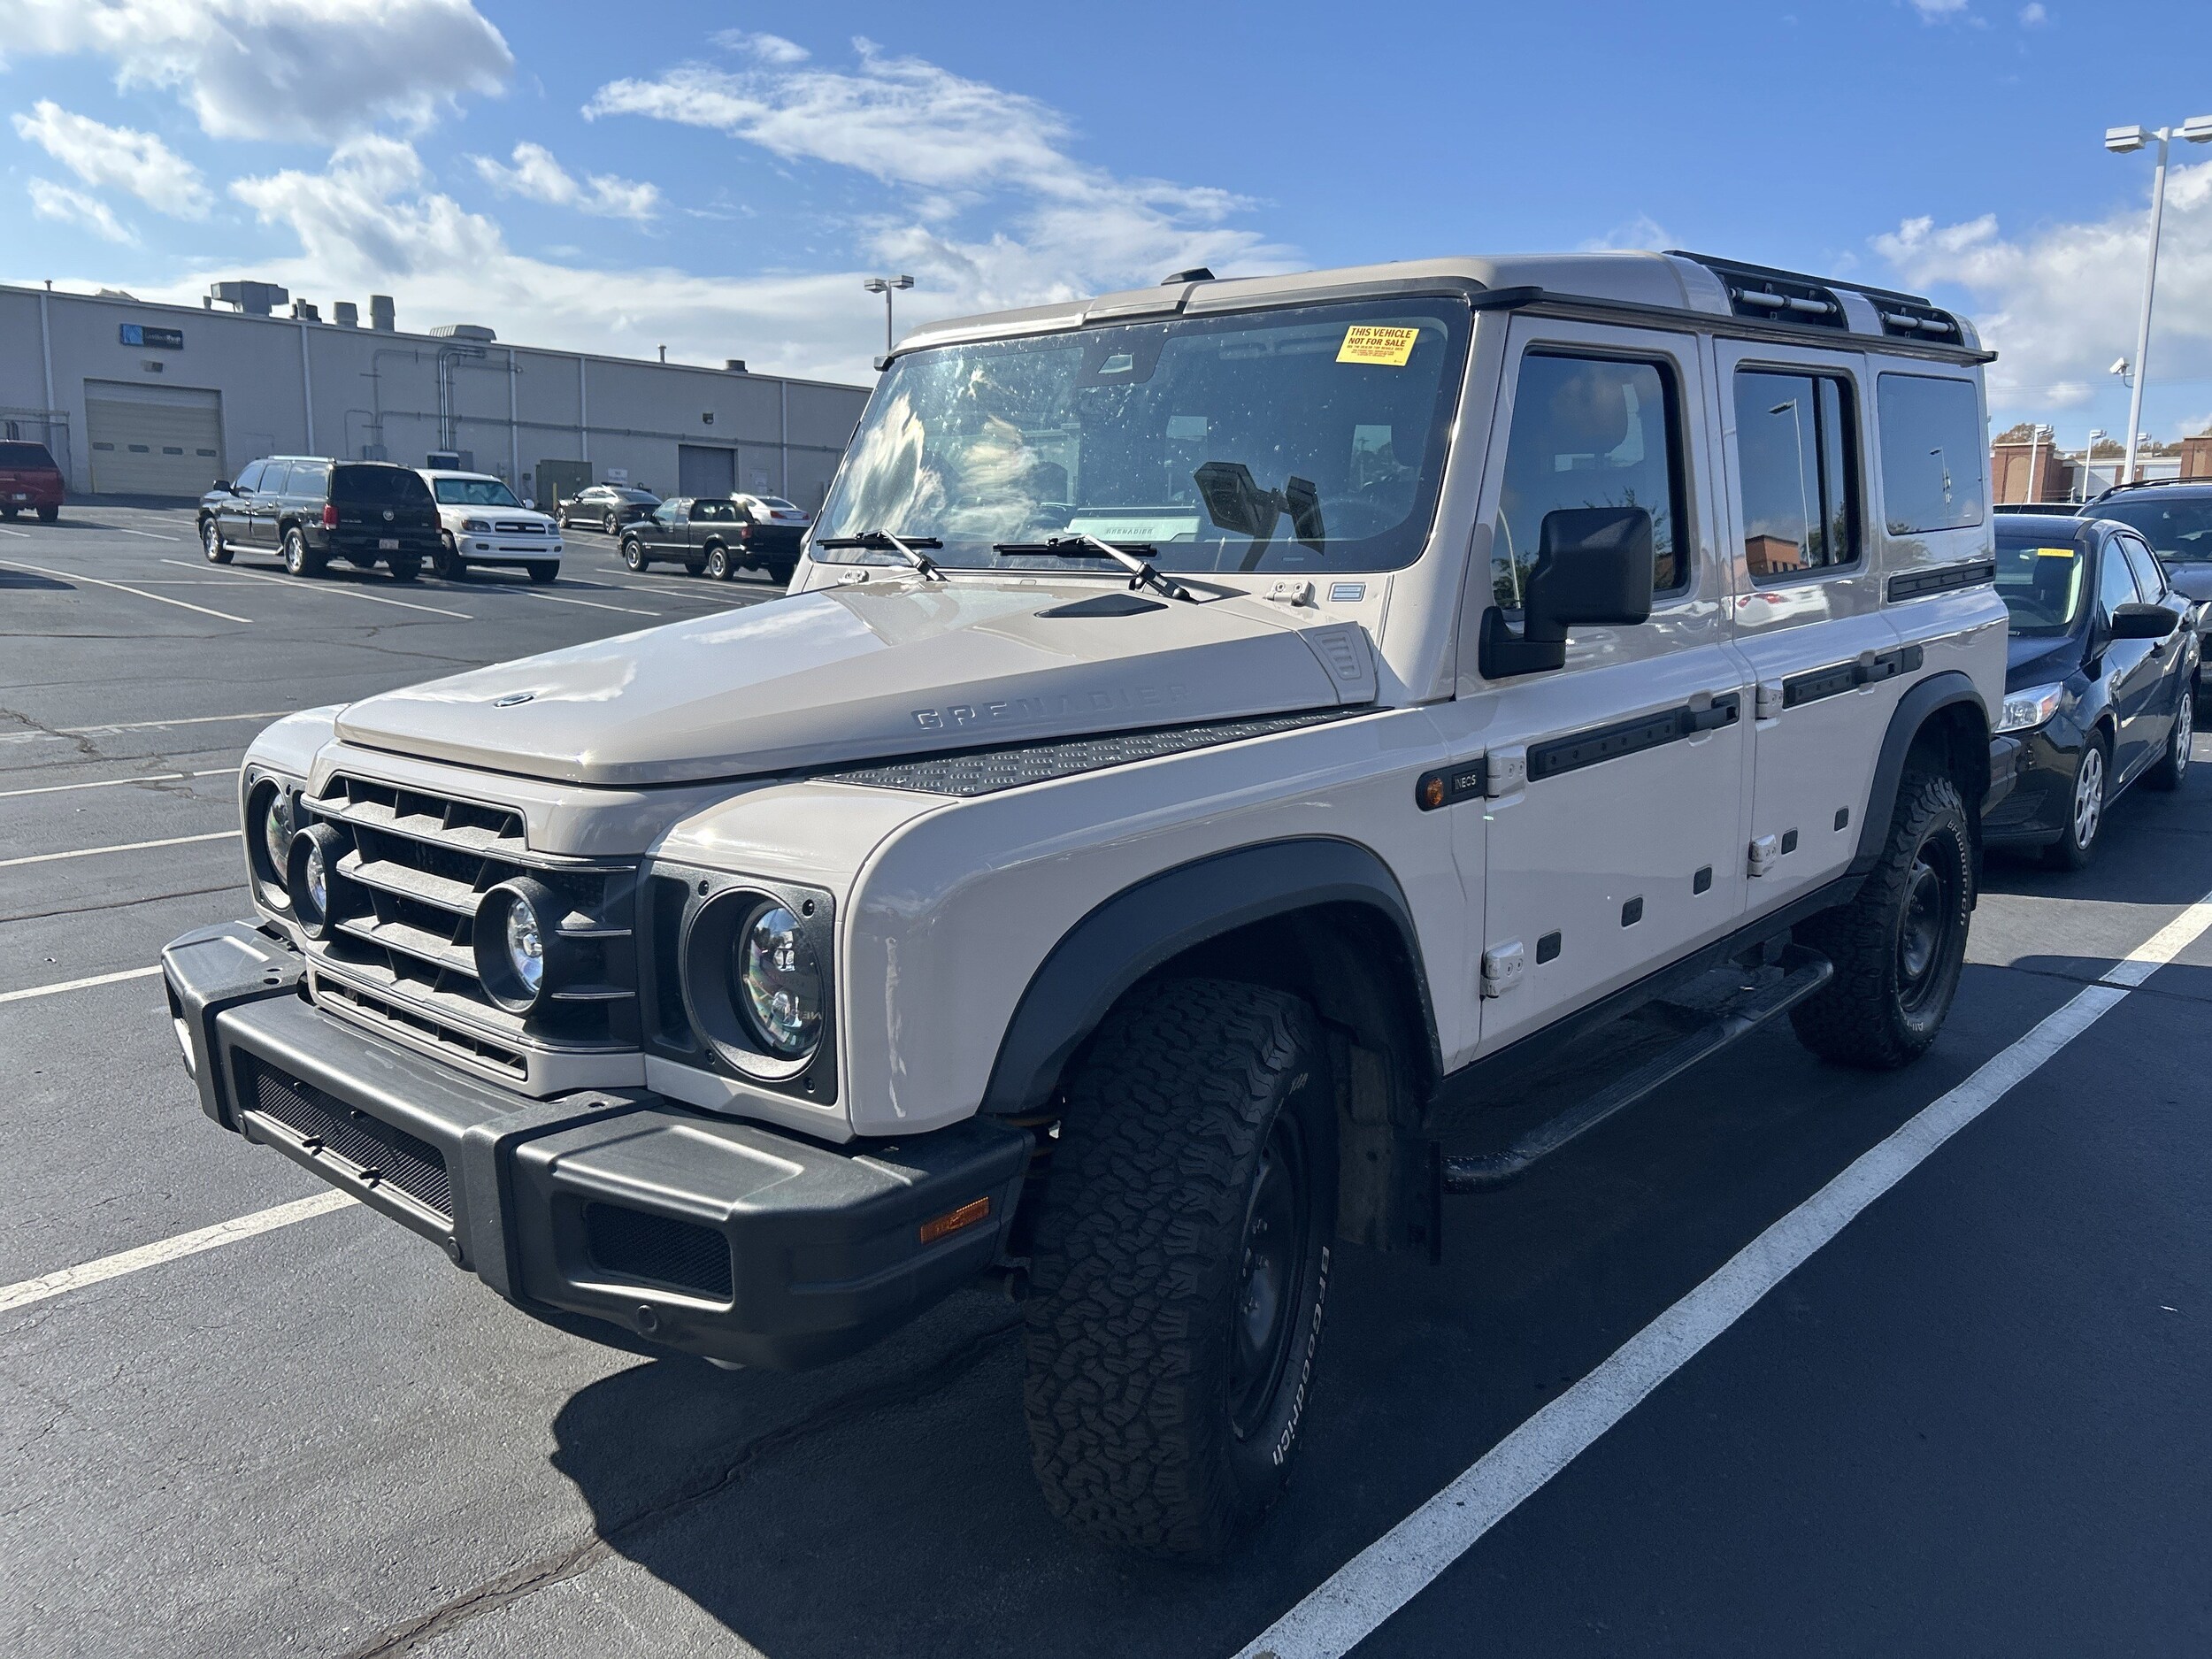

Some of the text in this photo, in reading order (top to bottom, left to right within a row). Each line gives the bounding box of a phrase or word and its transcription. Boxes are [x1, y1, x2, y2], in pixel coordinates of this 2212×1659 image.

[1351, 327, 1413, 339] THIS VEHICLE
[1455, 774, 1477, 790] INEOS
